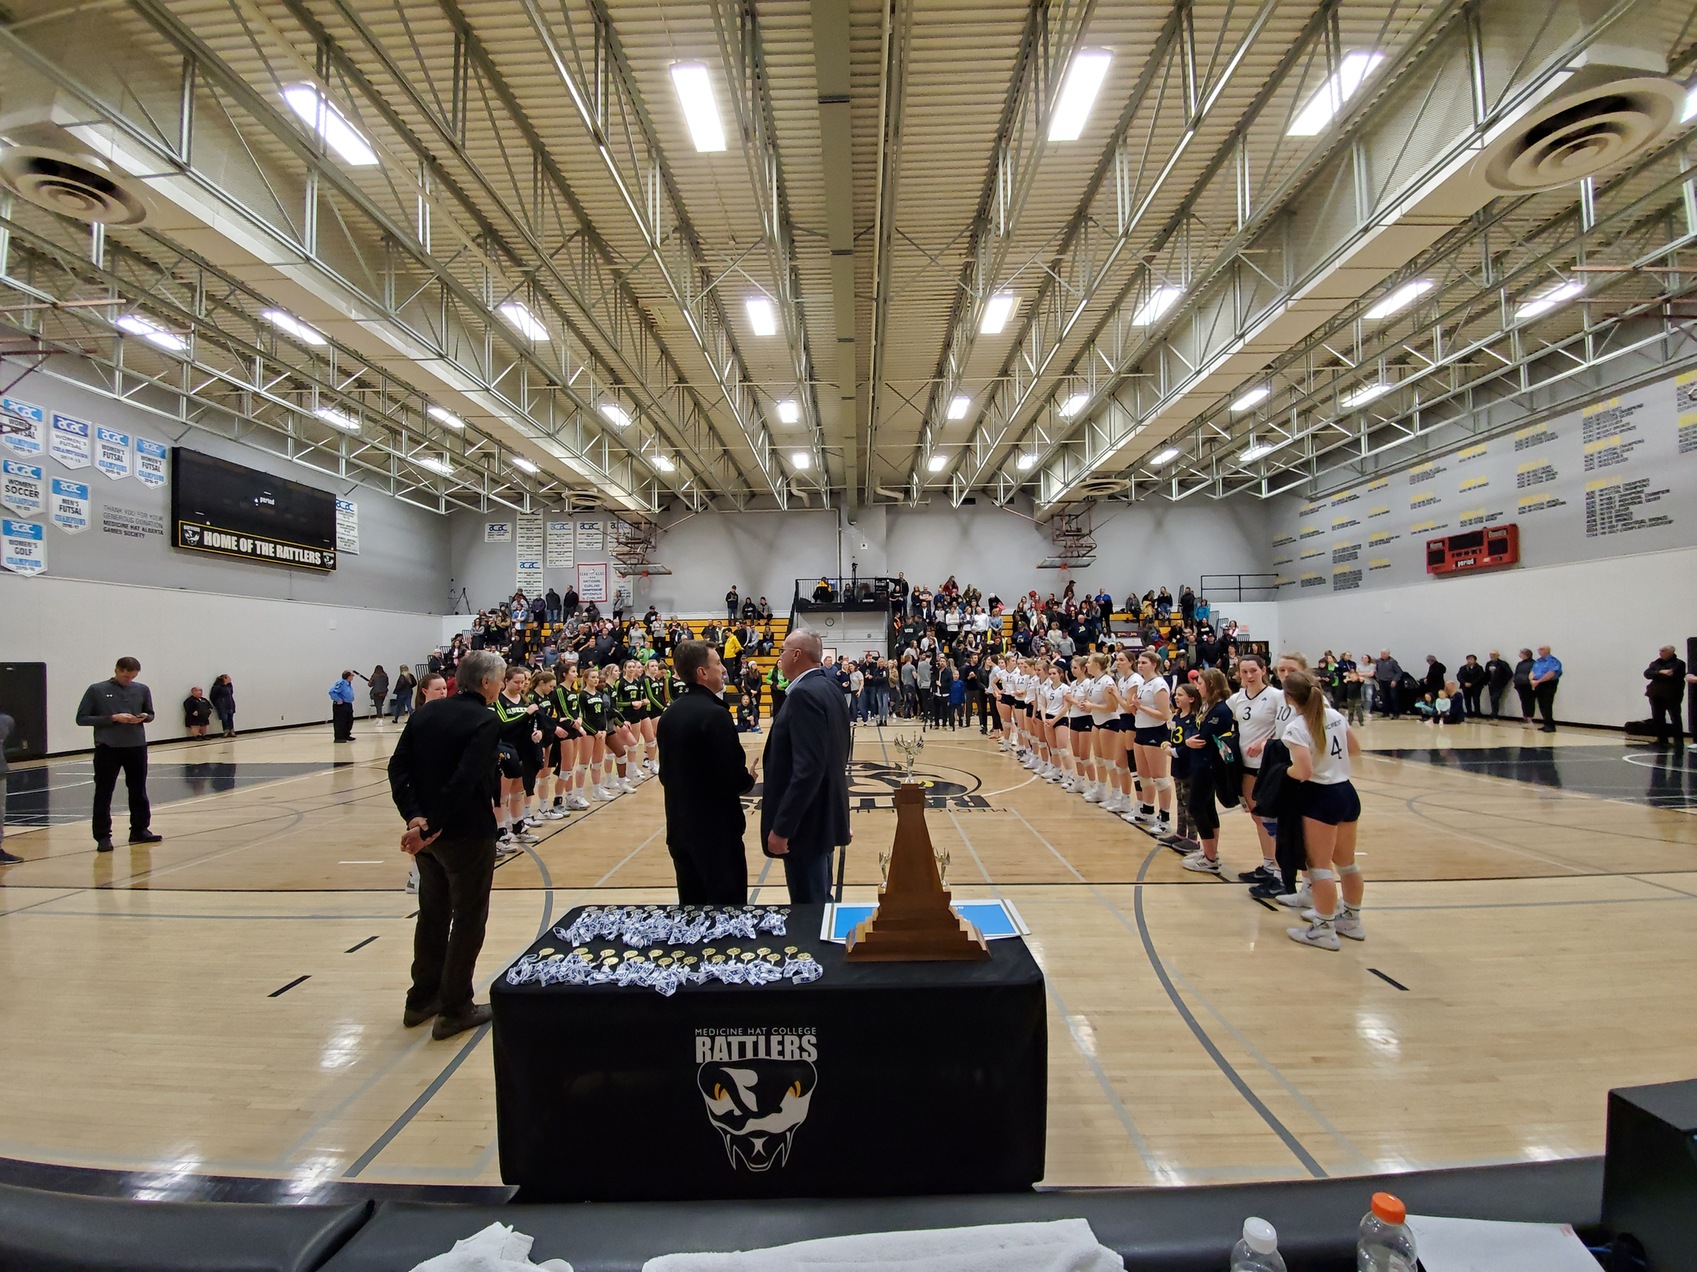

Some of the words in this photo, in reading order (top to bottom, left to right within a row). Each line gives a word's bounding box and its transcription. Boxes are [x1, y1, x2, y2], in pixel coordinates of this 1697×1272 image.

[57, 417, 85, 436] acac
[55, 434, 86, 446] WOMEN'S
[101, 429, 125, 445] acac
[60, 440, 82, 450] FUTSAL
[102, 444, 124, 456] WOMEN'S
[103, 451, 123, 462] FUTSAL
[140, 456, 162, 465] WOMEN'S
[8, 462, 38, 478] acac
[142, 462, 161, 472] FUTSAL
[8, 479, 38, 490] WOMEN'S
[59, 481, 81, 494] acac
[5, 485, 40, 499] SOCCER
[62, 499, 79, 507] MEN'S
[59, 505, 82, 515] FUTSAL
[9, 540, 38, 548] WOMEN'S
[203, 530, 238, 550] HOME
[239, 538, 254, 552] OF
[255, 541, 275, 556] THE
[276, 546, 321, 565] RATTLERS
[15, 547, 32, 556] GOLF
[1457, 558, 1474, 567] period
[1242, 707, 1252, 720] 3
[1277, 706, 1291, 721] 10
[1331, 735, 1342, 759] 4
[695, 1035, 818, 1063] RATTLERS
